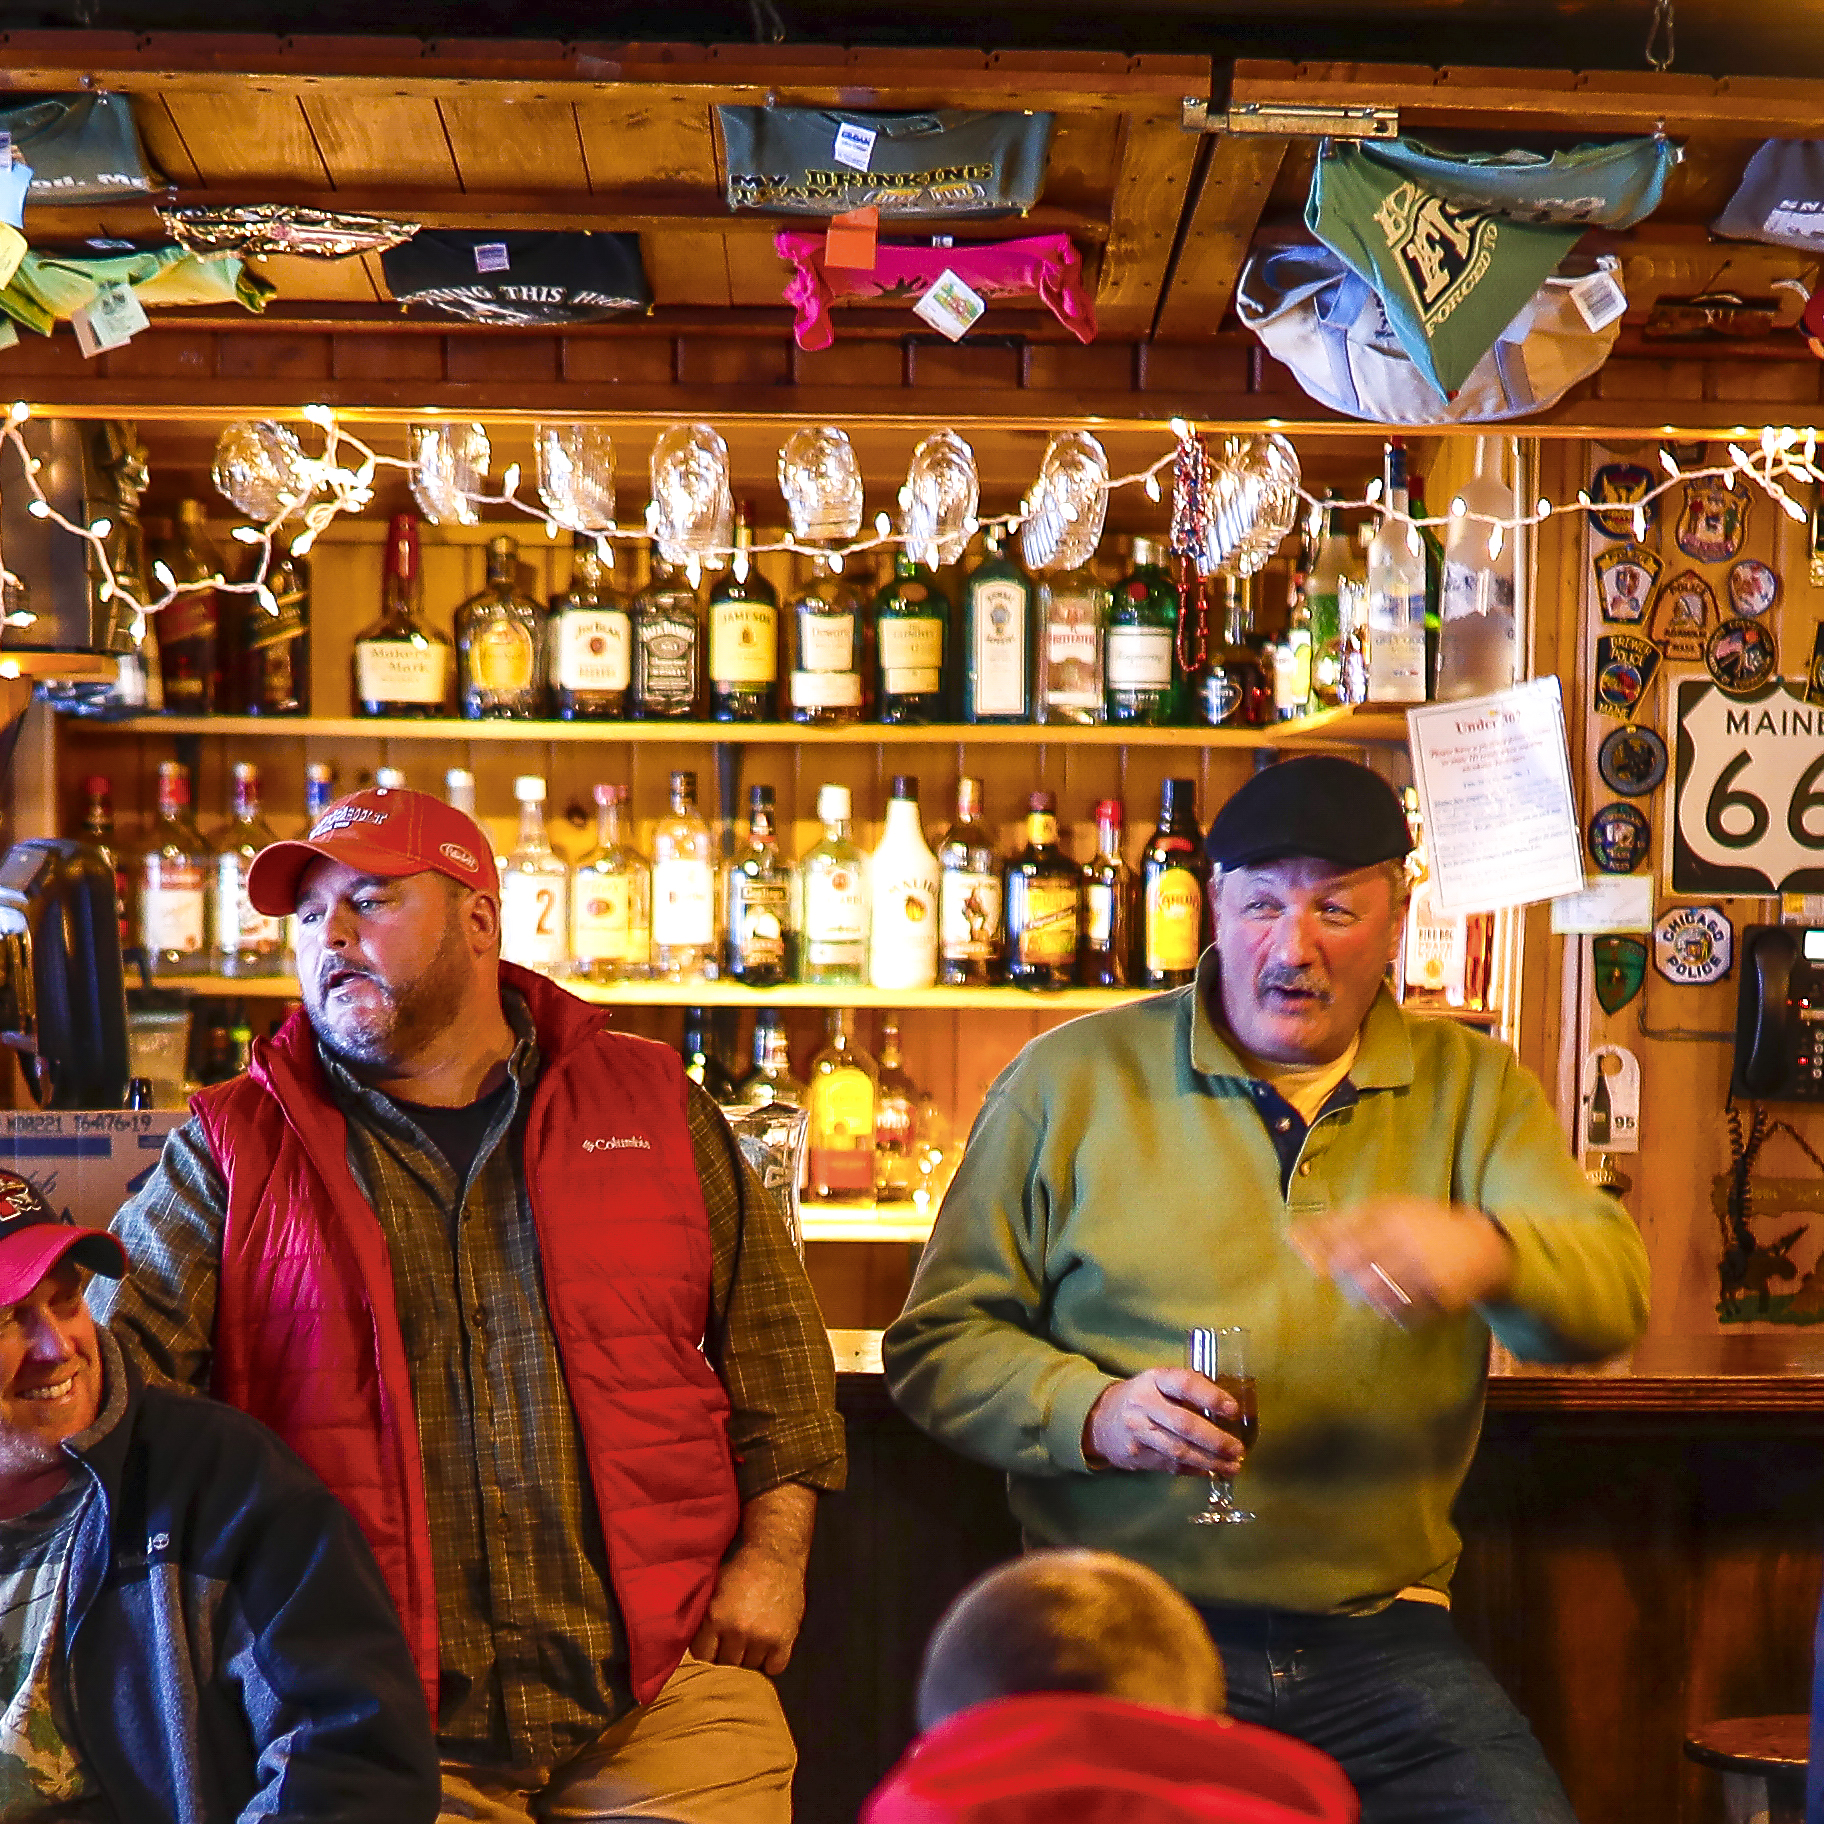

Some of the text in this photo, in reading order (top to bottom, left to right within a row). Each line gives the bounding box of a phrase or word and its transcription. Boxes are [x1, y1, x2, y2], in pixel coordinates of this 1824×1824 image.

[498, 283, 565, 304] THIS
[1454, 717, 1497, 735] Under
[1662, 911, 1725, 943] CHICAGO
[1666, 951, 1723, 979] POLICE
[595, 1134, 651, 1151] Columbia
